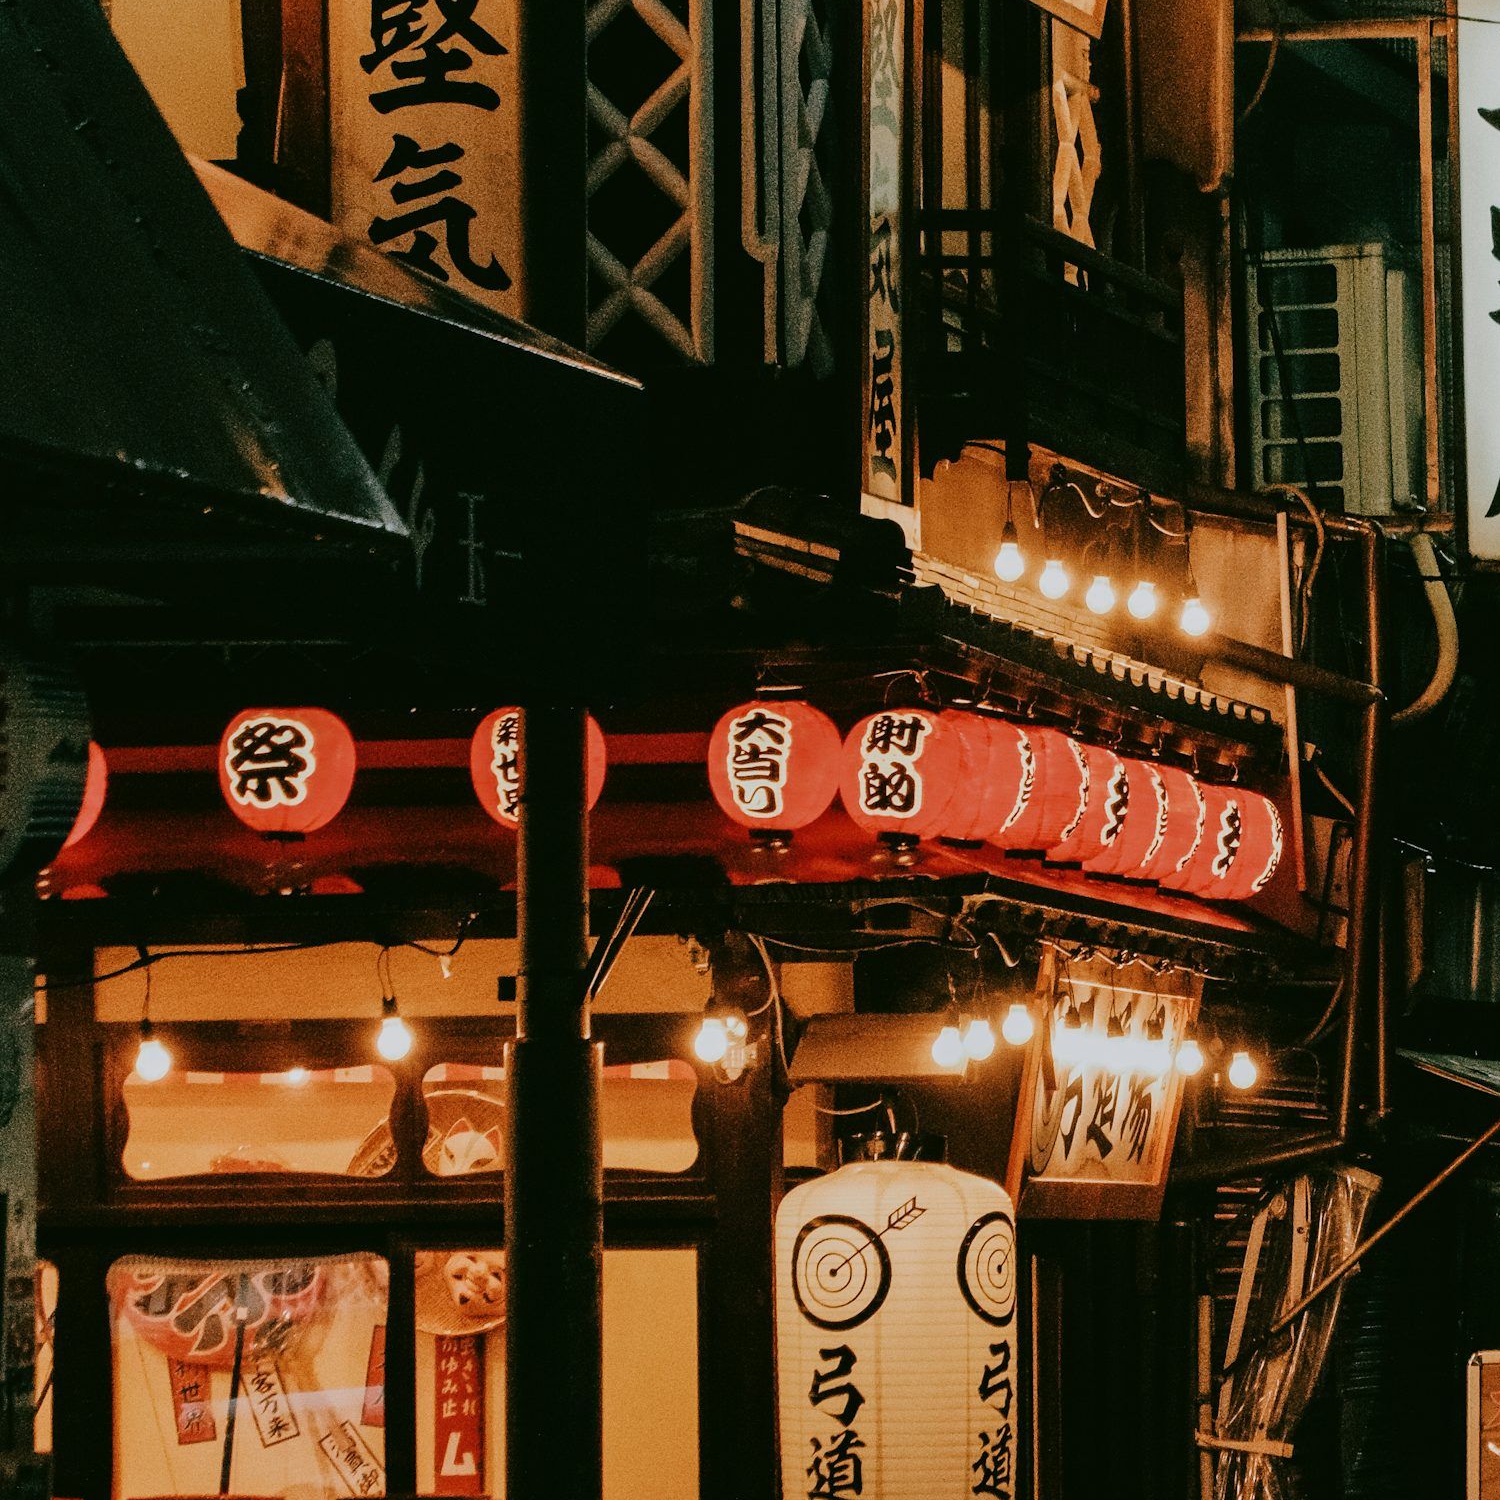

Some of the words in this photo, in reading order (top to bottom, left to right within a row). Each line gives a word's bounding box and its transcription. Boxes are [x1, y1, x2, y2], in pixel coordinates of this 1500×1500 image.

[230, 720, 309, 803] 祭
[733, 710, 788, 815] 大当り
